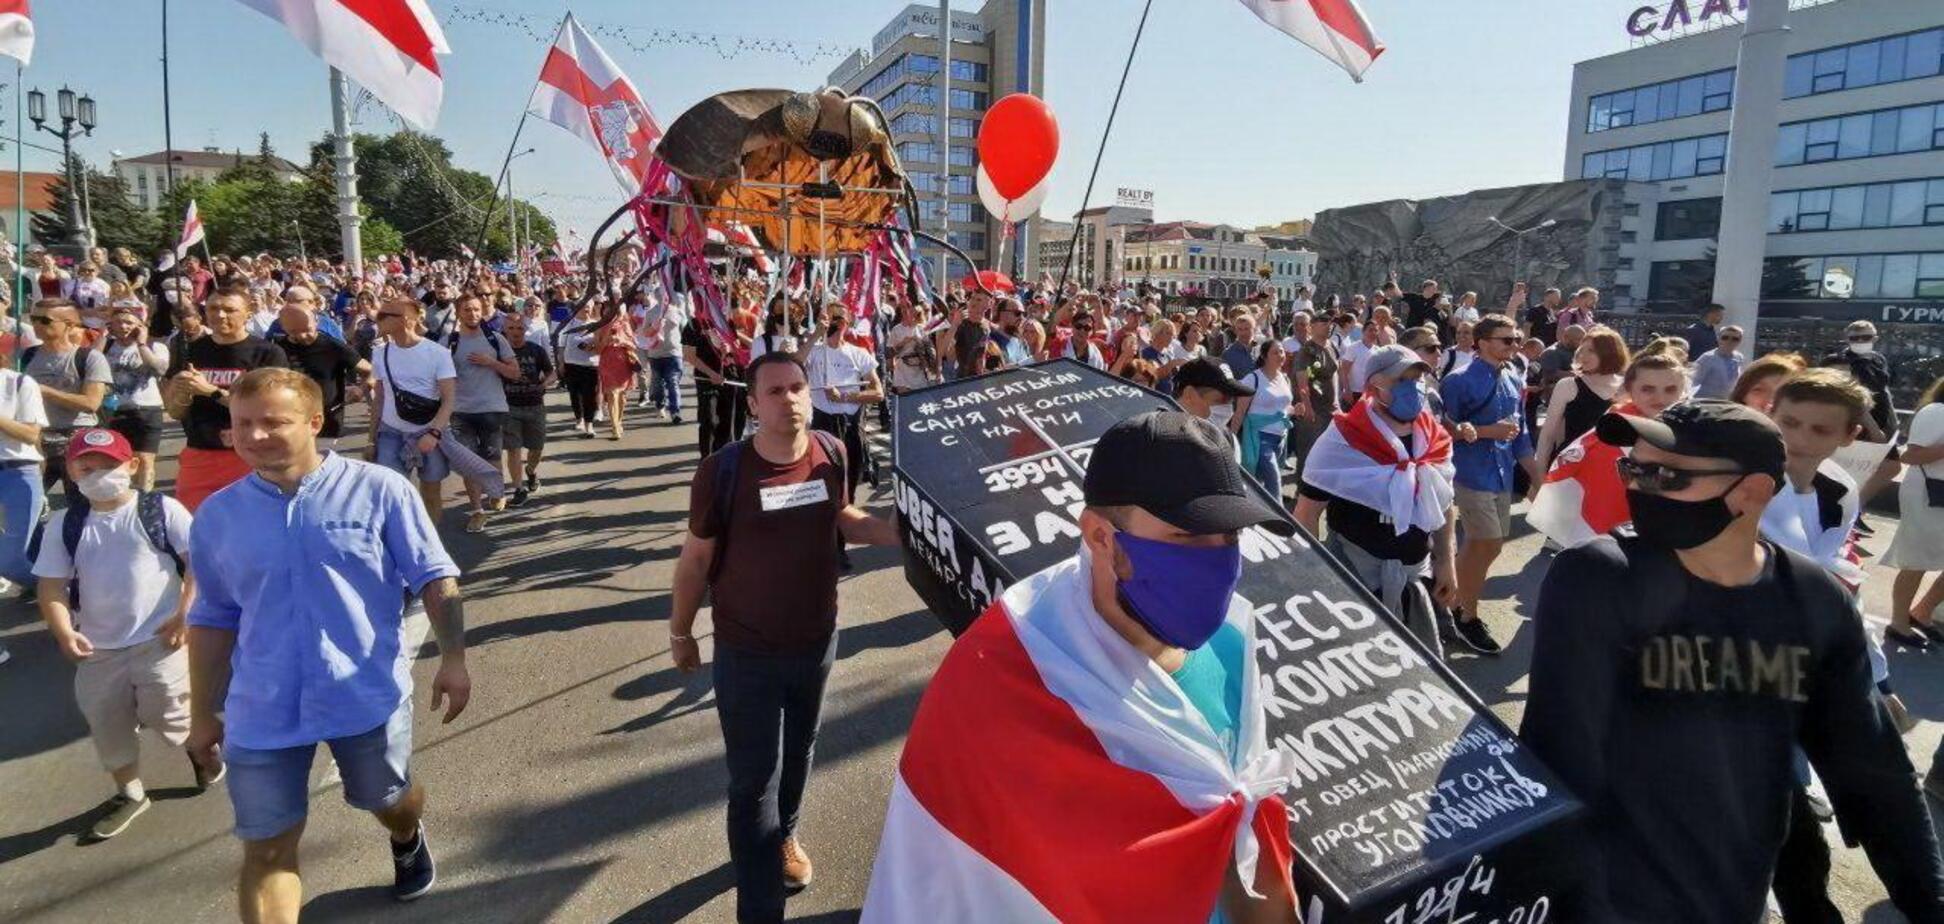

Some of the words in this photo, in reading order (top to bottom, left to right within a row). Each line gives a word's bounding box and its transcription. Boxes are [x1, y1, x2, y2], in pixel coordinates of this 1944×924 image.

[1626, 0, 1748, 37] СЛА
[909, 411, 985, 433] САНЯ
[998, 403, 1034, 418] НЕ
[1036, 385, 1143, 410] ОСТАНЕТСЯ
[941, 435, 958, 446] С
[984, 456, 1068, 492] 1994
[1254, 591, 1376, 660] ЕСЬ
[1261, 631, 1428, 718] КОИТСЯ
[1642, 635, 1811, 702] DREAME
[1274, 681, 1476, 790] ИКТАТУРА
